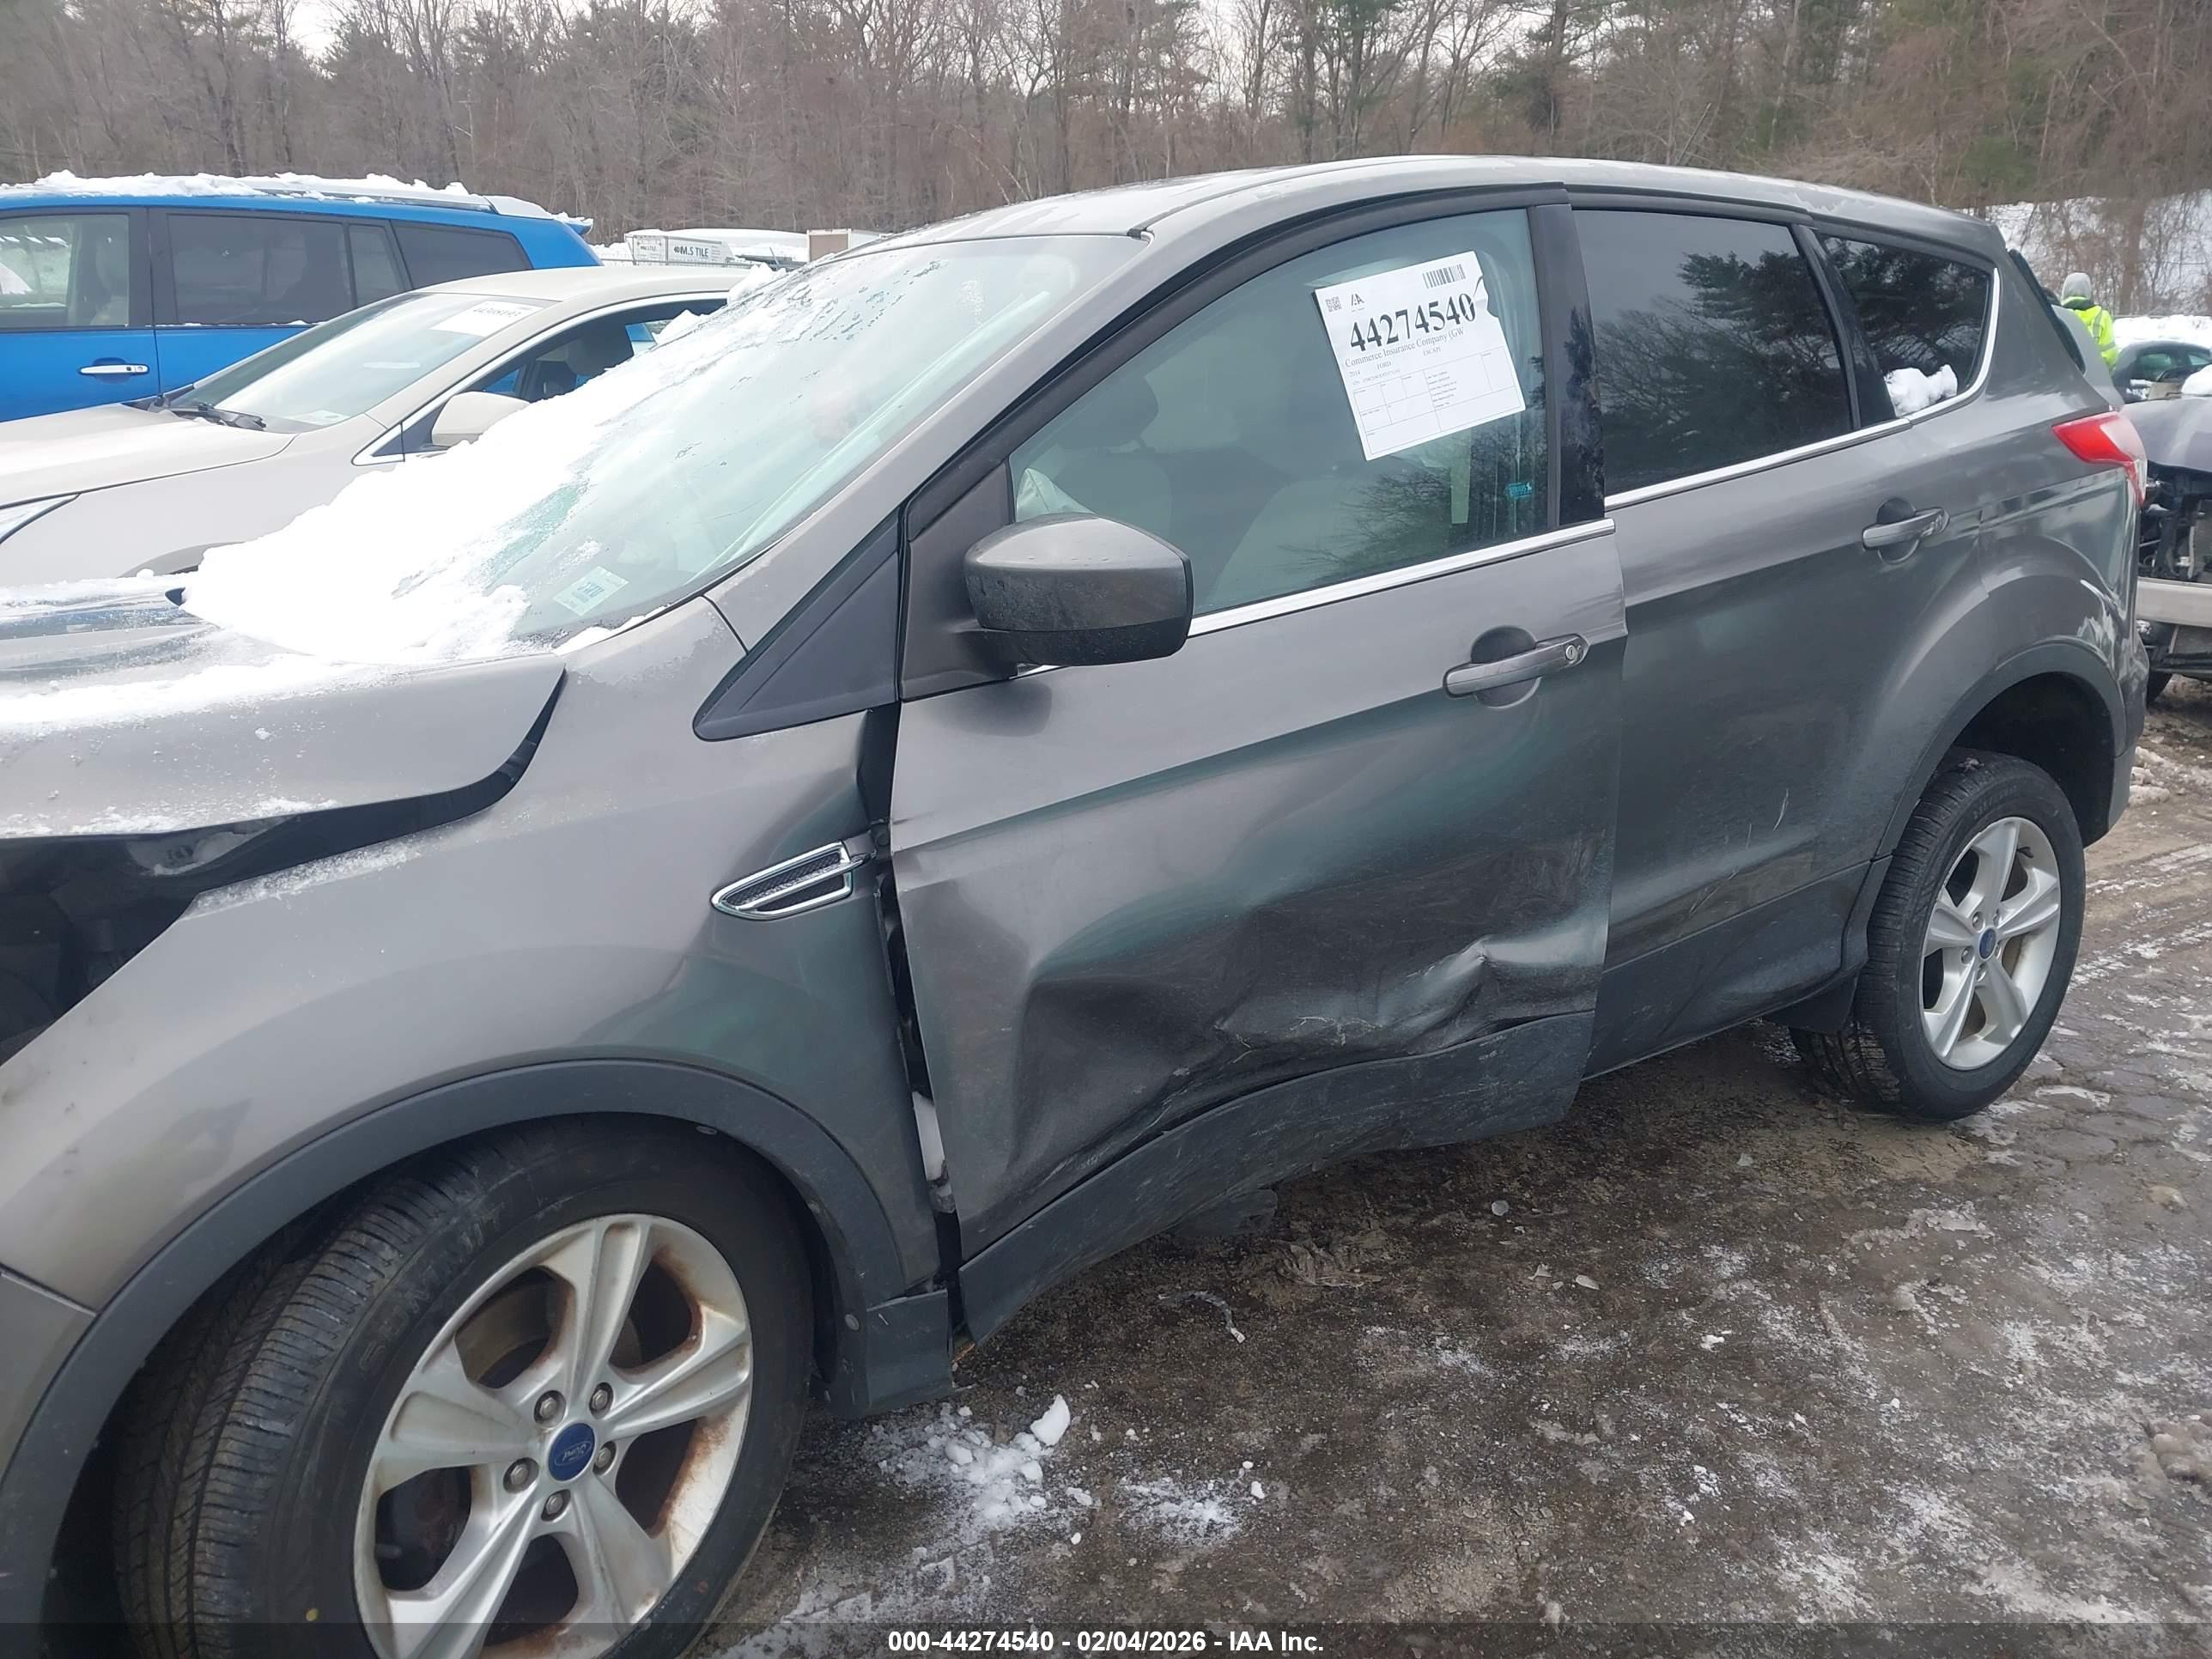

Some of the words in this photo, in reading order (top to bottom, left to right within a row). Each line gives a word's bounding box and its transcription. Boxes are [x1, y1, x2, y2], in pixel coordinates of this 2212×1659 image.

[696, 246, 709, 258] TILE
[1350, 293, 1476, 352] 44274540
[1345, 350, 1383, 368] Commerce
[1383, 342, 1416, 357] Insurance
[1416, 333, 1448, 348] Company
